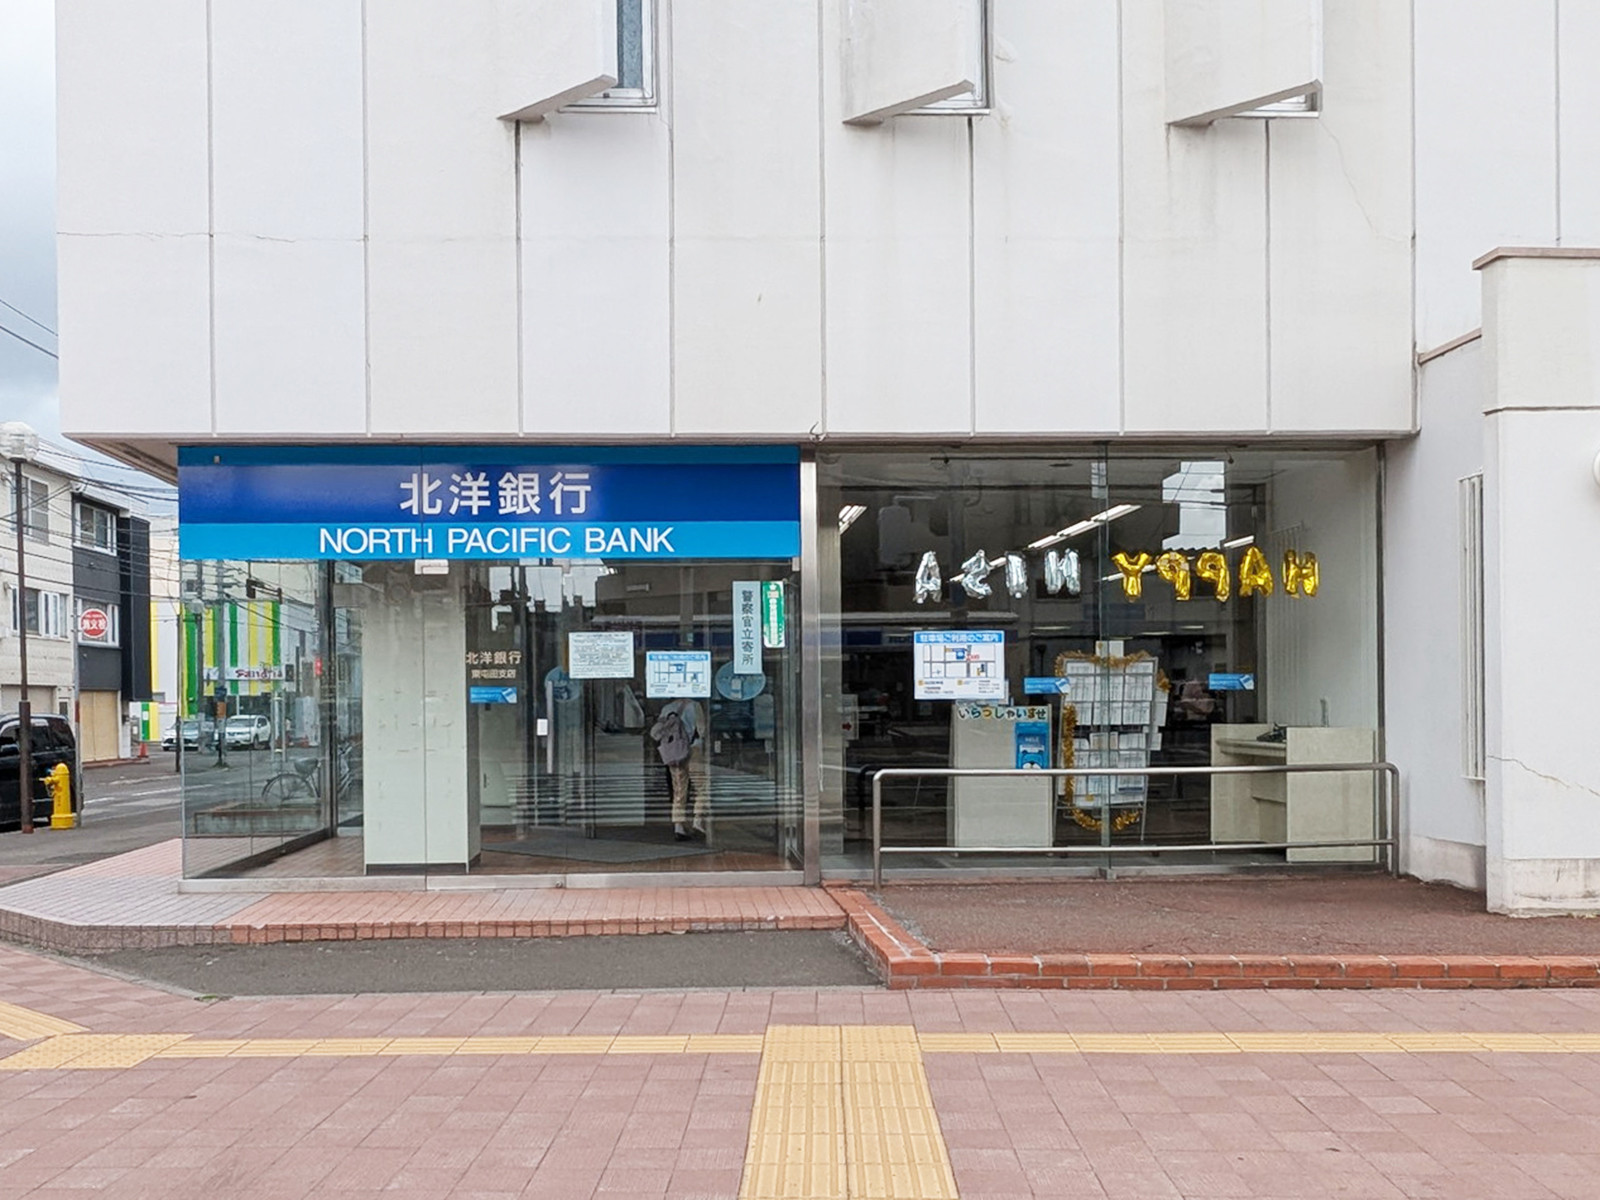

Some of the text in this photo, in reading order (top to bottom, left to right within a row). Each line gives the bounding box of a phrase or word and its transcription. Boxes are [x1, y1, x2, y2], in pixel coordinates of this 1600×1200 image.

[399, 472, 592, 515] 北洋銀行
[319, 527, 675, 554] NORTH PACIFIC BANK
[741, 590, 754, 666] 警察官立寄所
[465, 651, 521, 664] 北洋銀行
[958, 707, 1047, 720] いらっしゃいませ
